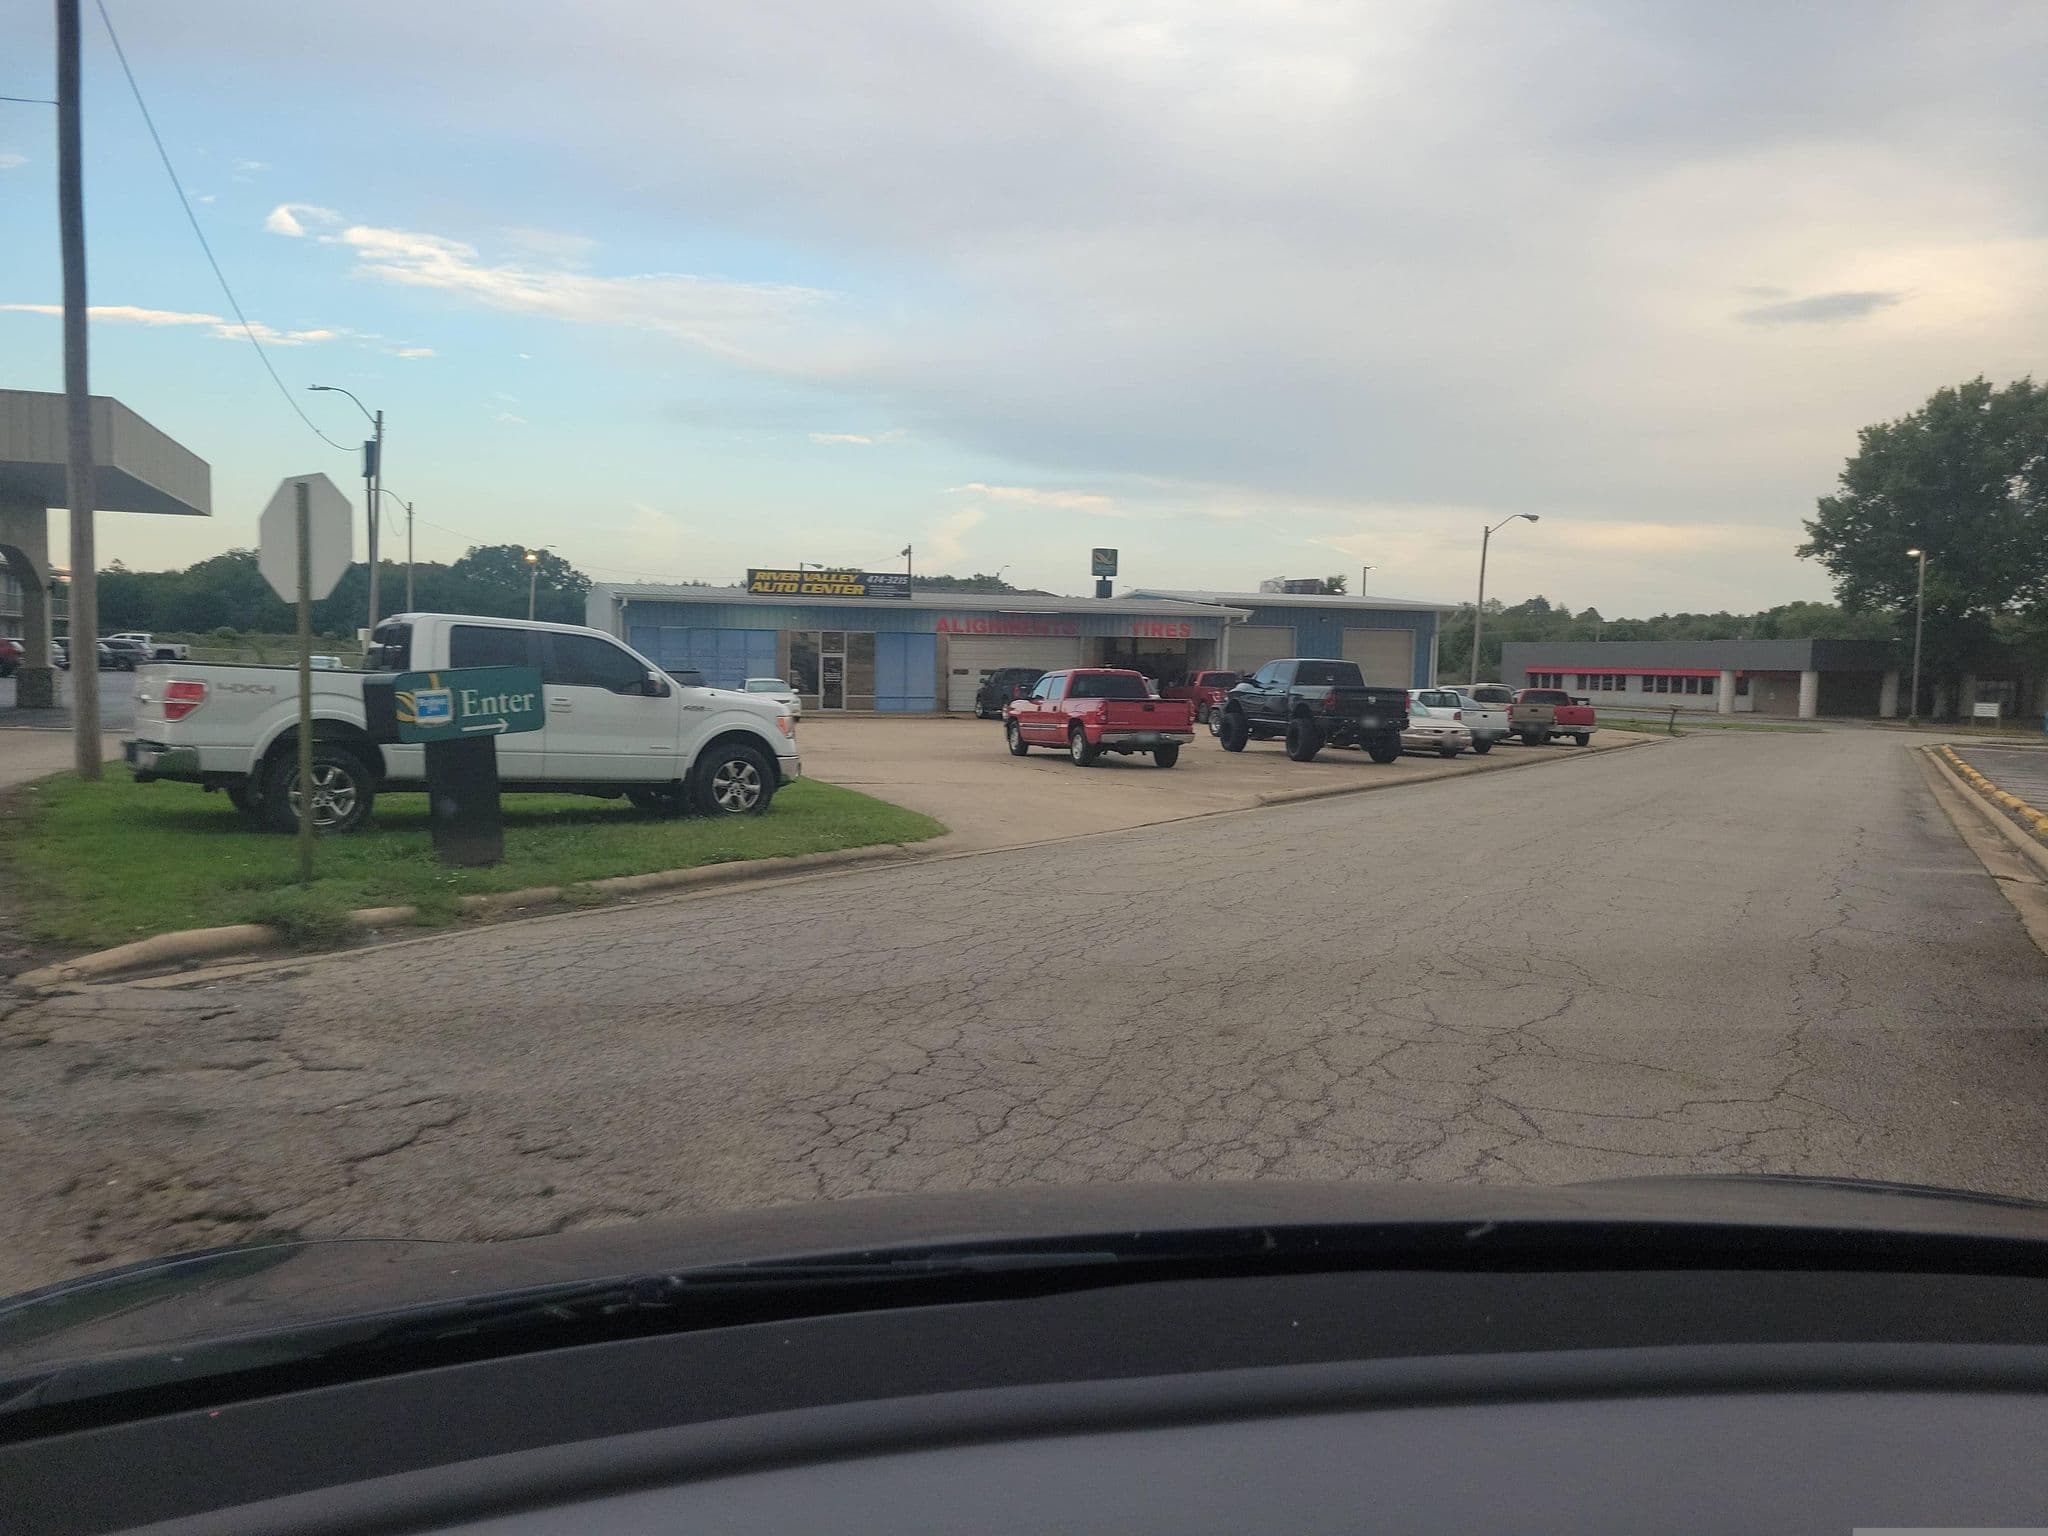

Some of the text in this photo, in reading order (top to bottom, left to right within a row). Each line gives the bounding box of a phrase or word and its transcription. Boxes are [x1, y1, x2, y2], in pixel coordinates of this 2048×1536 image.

[755, 572, 859, 583] RIVER VALLEY
[749, 582, 799, 593] AUTO
[801, 584, 866, 596] CENTER
[1131, 620, 1192, 638] TIRES
[459, 689, 536, 717] Enter
